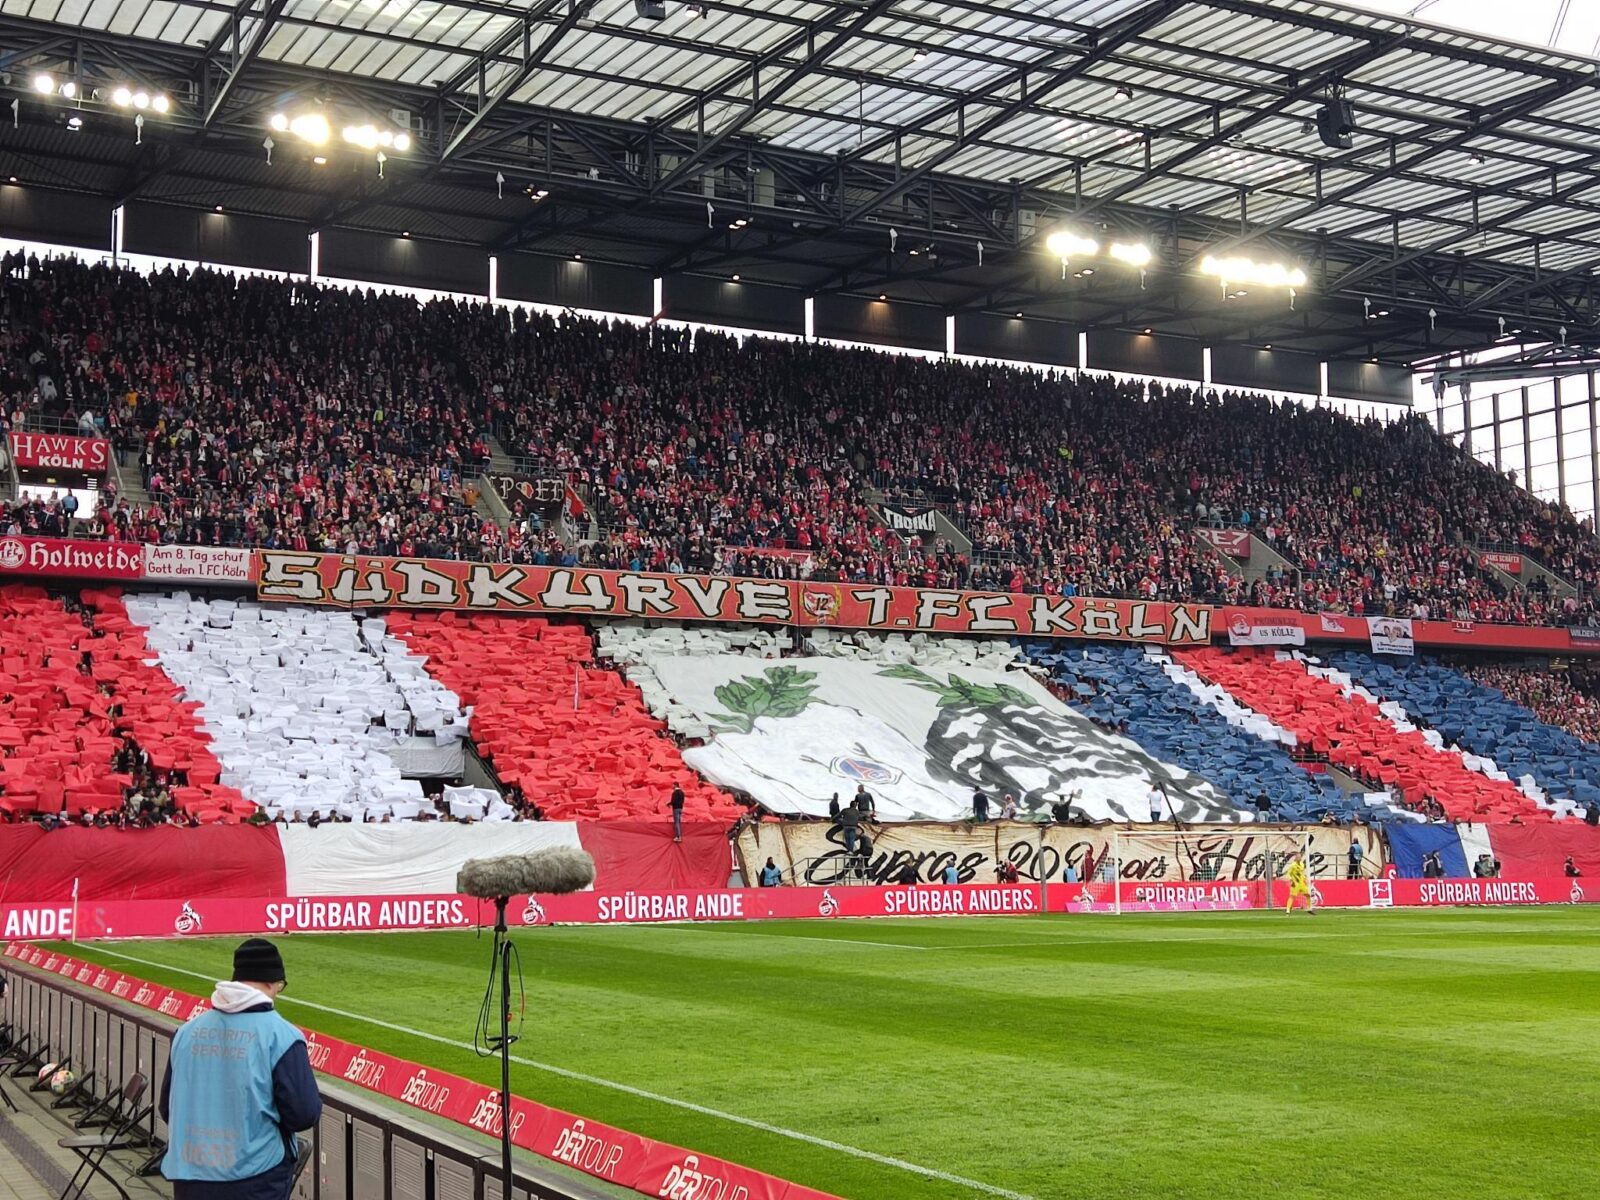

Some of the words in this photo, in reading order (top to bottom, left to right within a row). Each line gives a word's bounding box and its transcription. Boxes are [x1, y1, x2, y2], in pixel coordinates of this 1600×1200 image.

[13, 434, 106, 465] HAWKS
[39, 455, 84, 469] KÖLN
[30, 541, 141, 571] Holweide
[148, 562, 172, 574] Gott
[175, 563, 195, 574] den
[206, 564, 220, 575] FC
[222, 564, 246, 577] Köln
[152, 548, 172, 559] Am
[176, 548, 186, 559] 8.
[189, 548, 208, 562] Tag
[212, 550, 244, 562] schuf
[260, 552, 792, 620] SÜDKURVE
[1031, 596, 1211, 642] KÖLN
[1008, 841, 1060, 882] 20
[598, 891, 689, 920] SPÜRBAR
[884, 886, 963, 913] SPÜRBAR
[969, 888, 1038, 911] ANDERS.
[1420, 879, 1480, 902] SPÜRBAR
[1485, 881, 1540, 901] ANDERS.
[265, 898, 371, 929] SPÜRBAR
[378, 899, 469, 926] ANDERS.
[192, 1027, 257, 1043] SECURITY
[191, 1044, 246, 1059] SERVICE
[344, 1055, 385, 1088] DERTOUR
[400, 1075, 450, 1113] DERTOUR
[552, 1127, 624, 1178] DERTOUR
